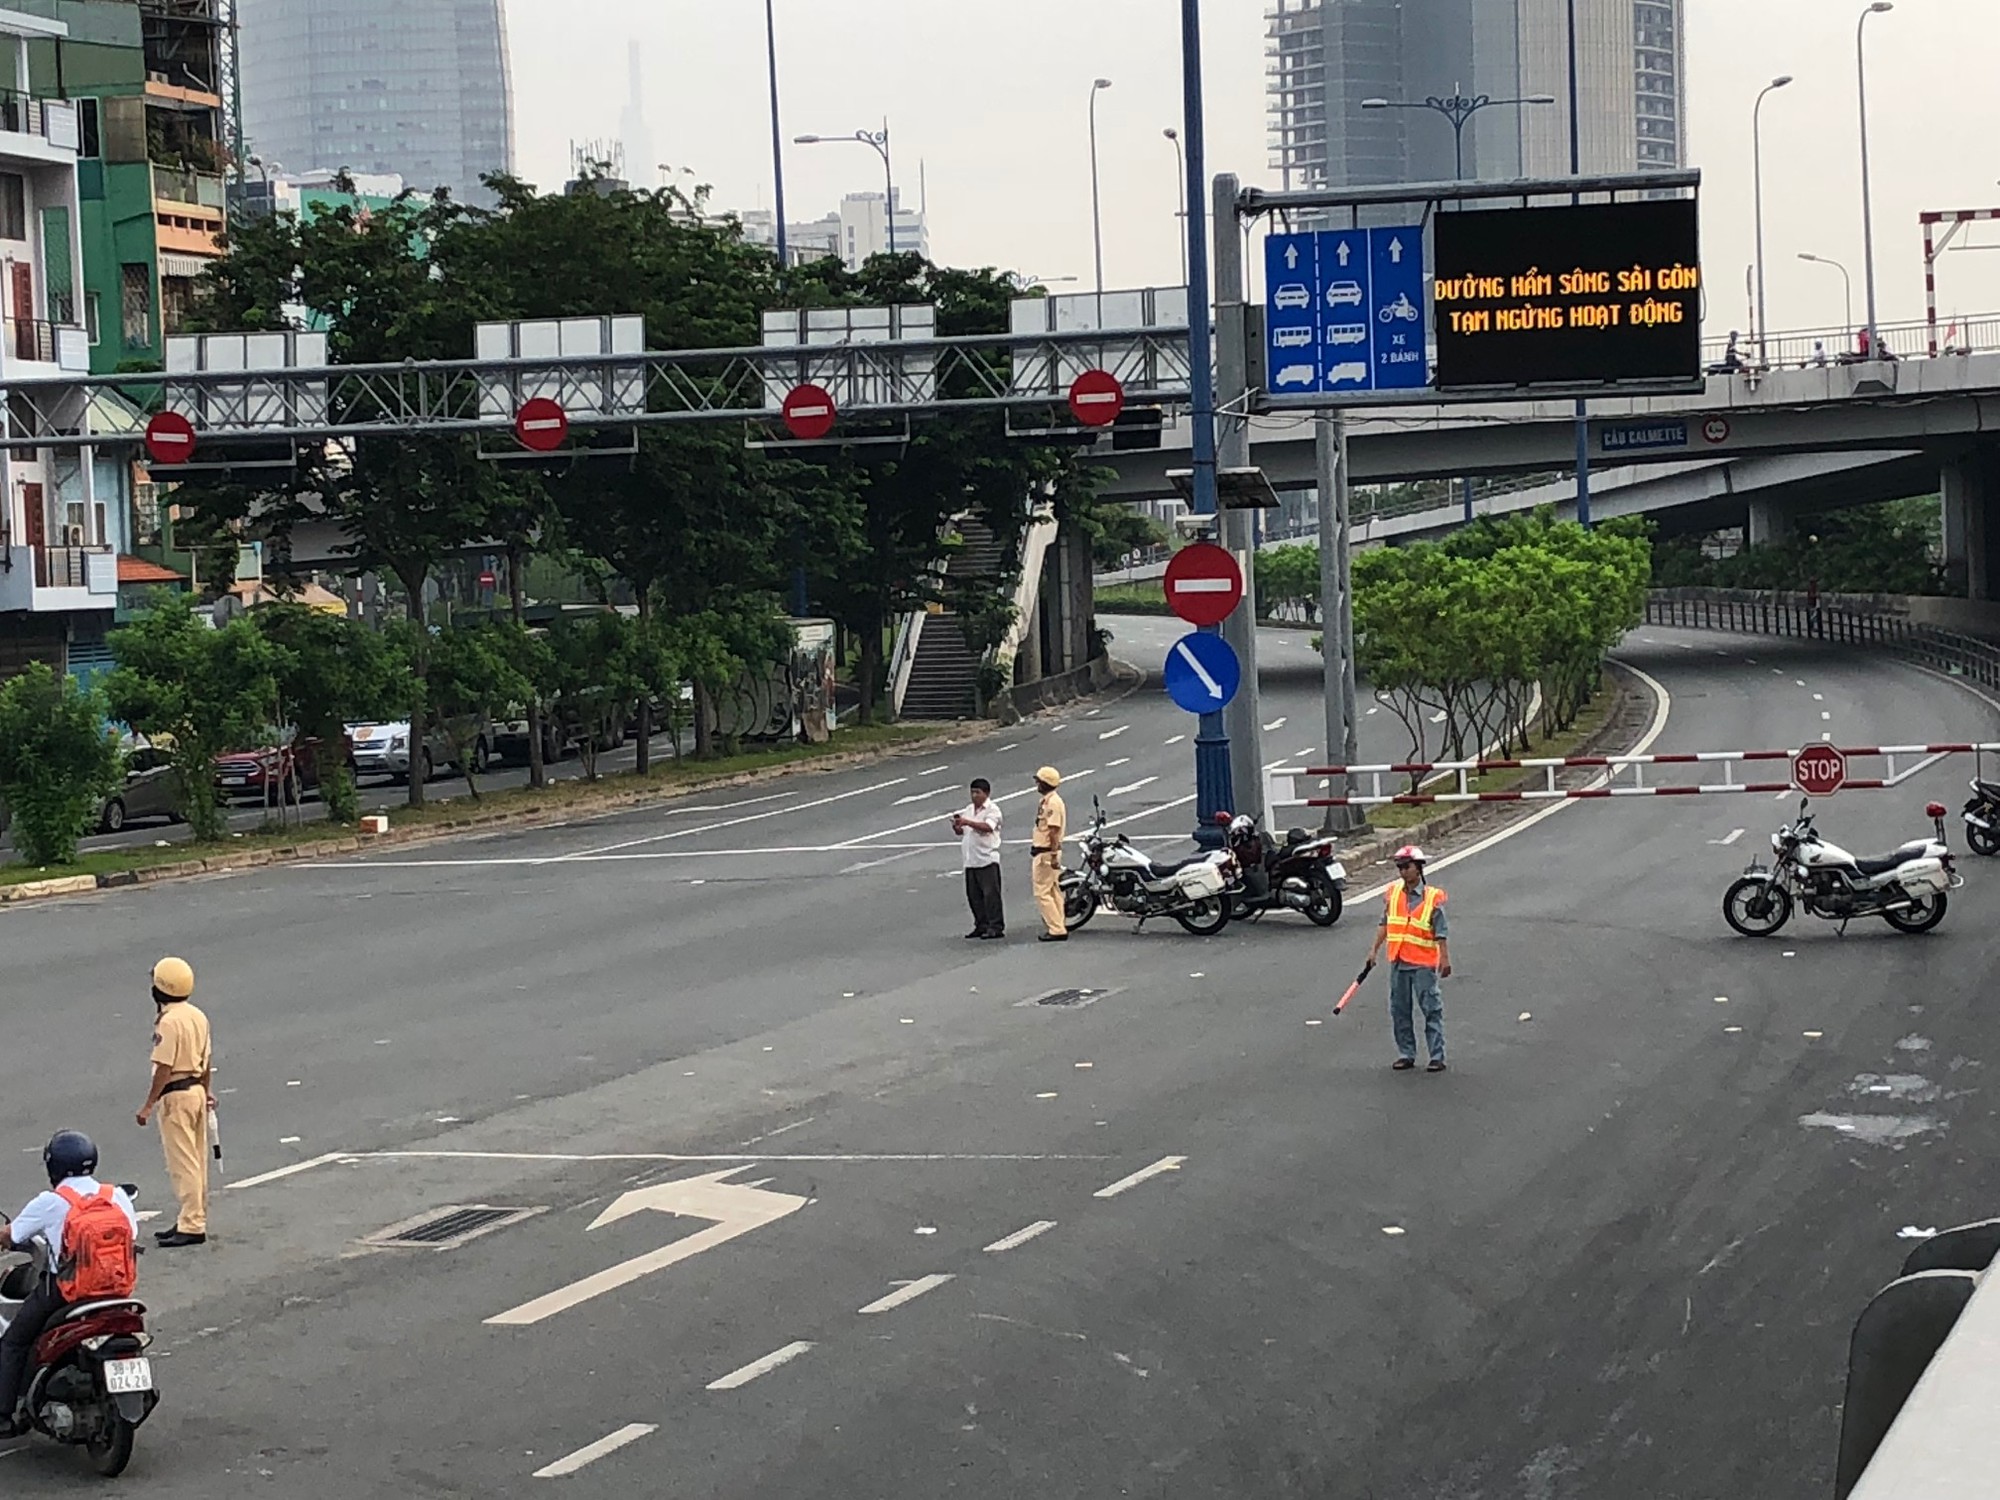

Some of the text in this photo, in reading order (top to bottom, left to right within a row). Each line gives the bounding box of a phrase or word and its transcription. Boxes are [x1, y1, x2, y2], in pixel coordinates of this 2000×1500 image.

[1559, 267, 1610, 295] SÔNG
[1617, 264, 1651, 292] SÀI
[1657, 262, 1697, 290] GÒN
[1449, 297, 1682, 336] TẠM NGỪNG HOẠT ĐỘNG
[1392, 333, 1406, 345] XE
[1381, 352, 1388, 364] 2
[1628, 427, 1685, 445] CALMETTE
[1799, 759, 1840, 780] STOP
